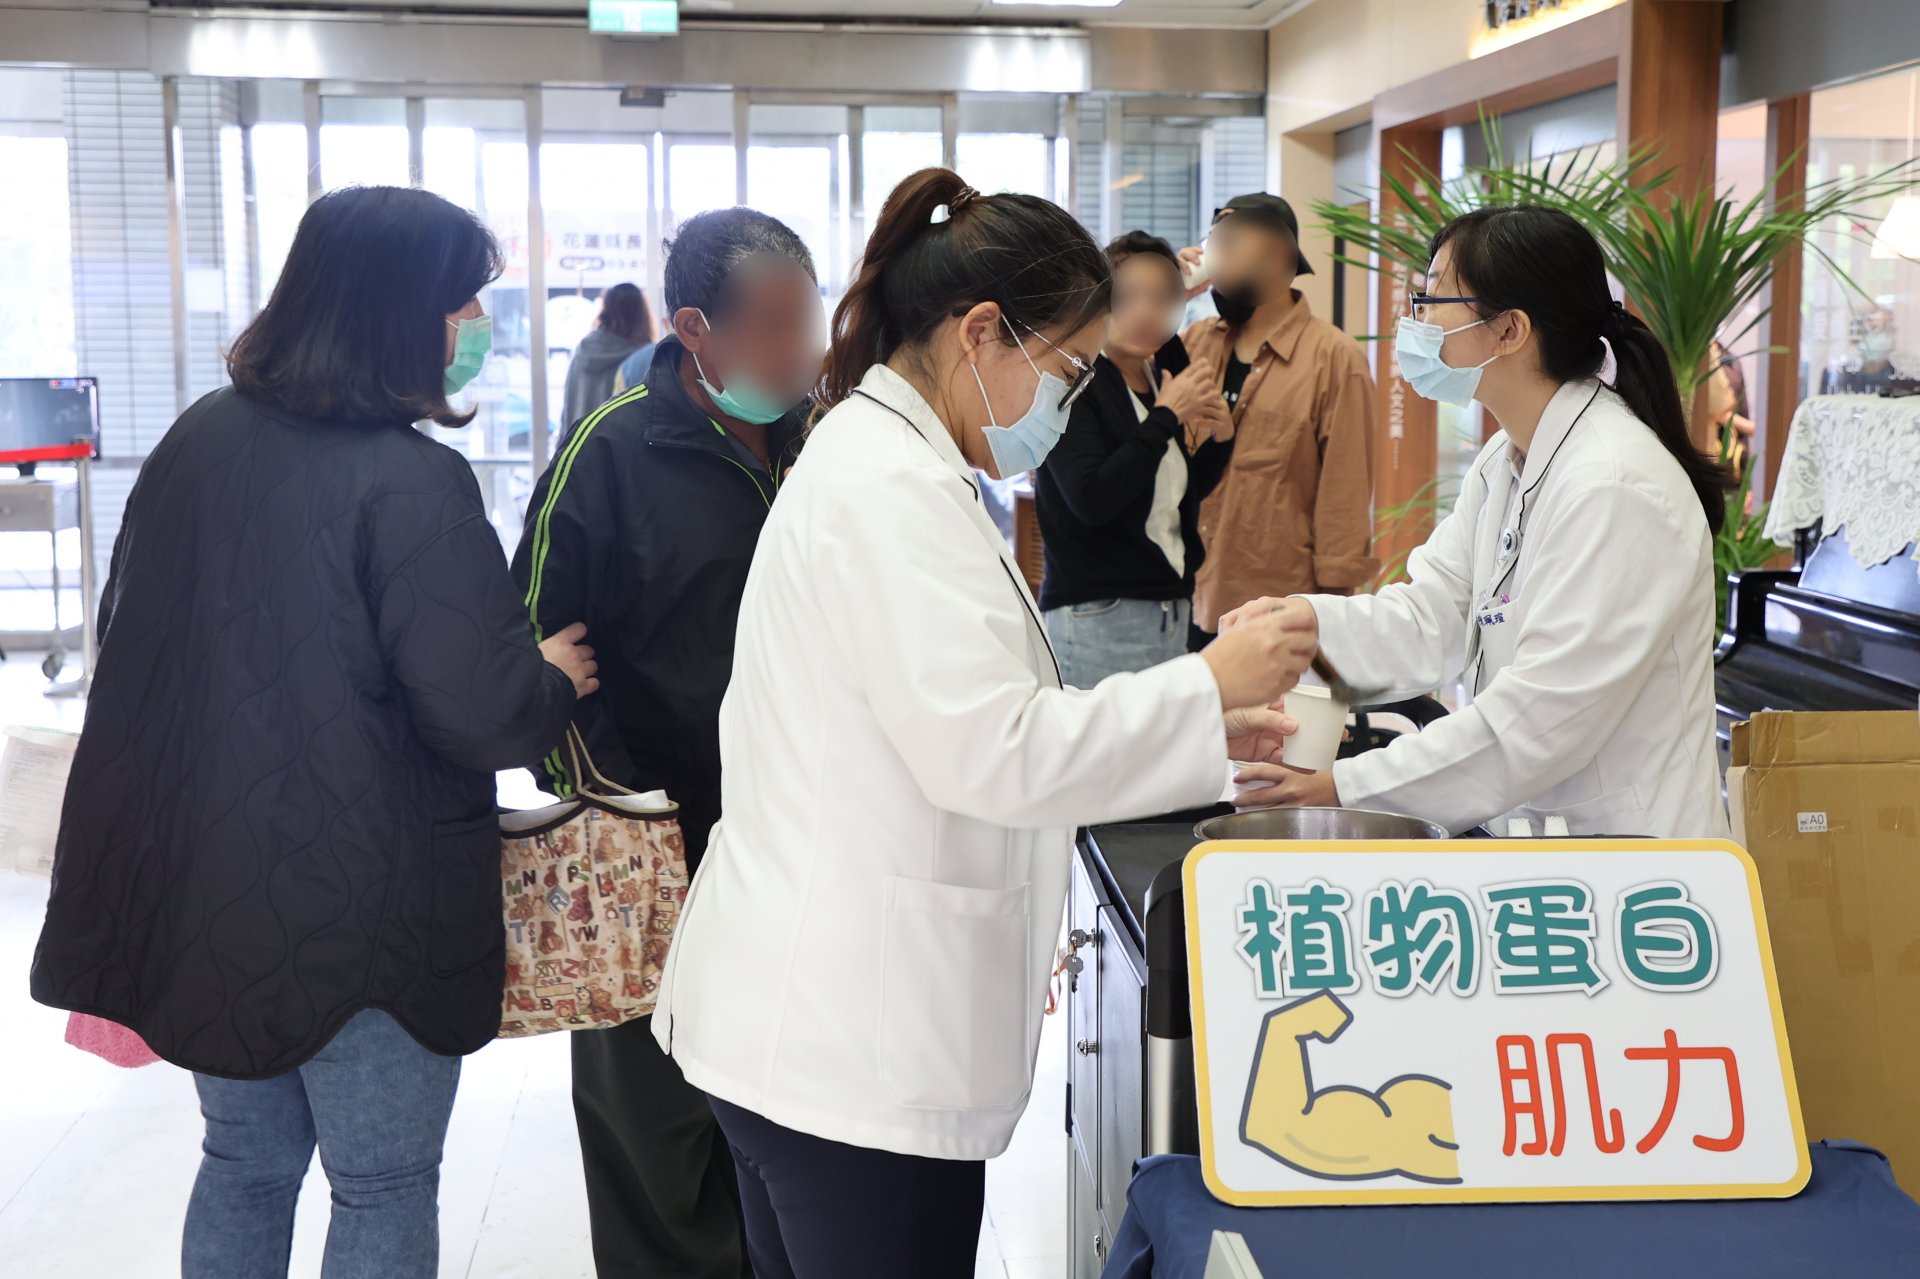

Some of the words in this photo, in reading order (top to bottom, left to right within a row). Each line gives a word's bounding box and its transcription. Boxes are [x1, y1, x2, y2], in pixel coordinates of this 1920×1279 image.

[1242, 884, 1713, 992] 植物蛋白
[1495, 1028, 1745, 1158] 肌力
